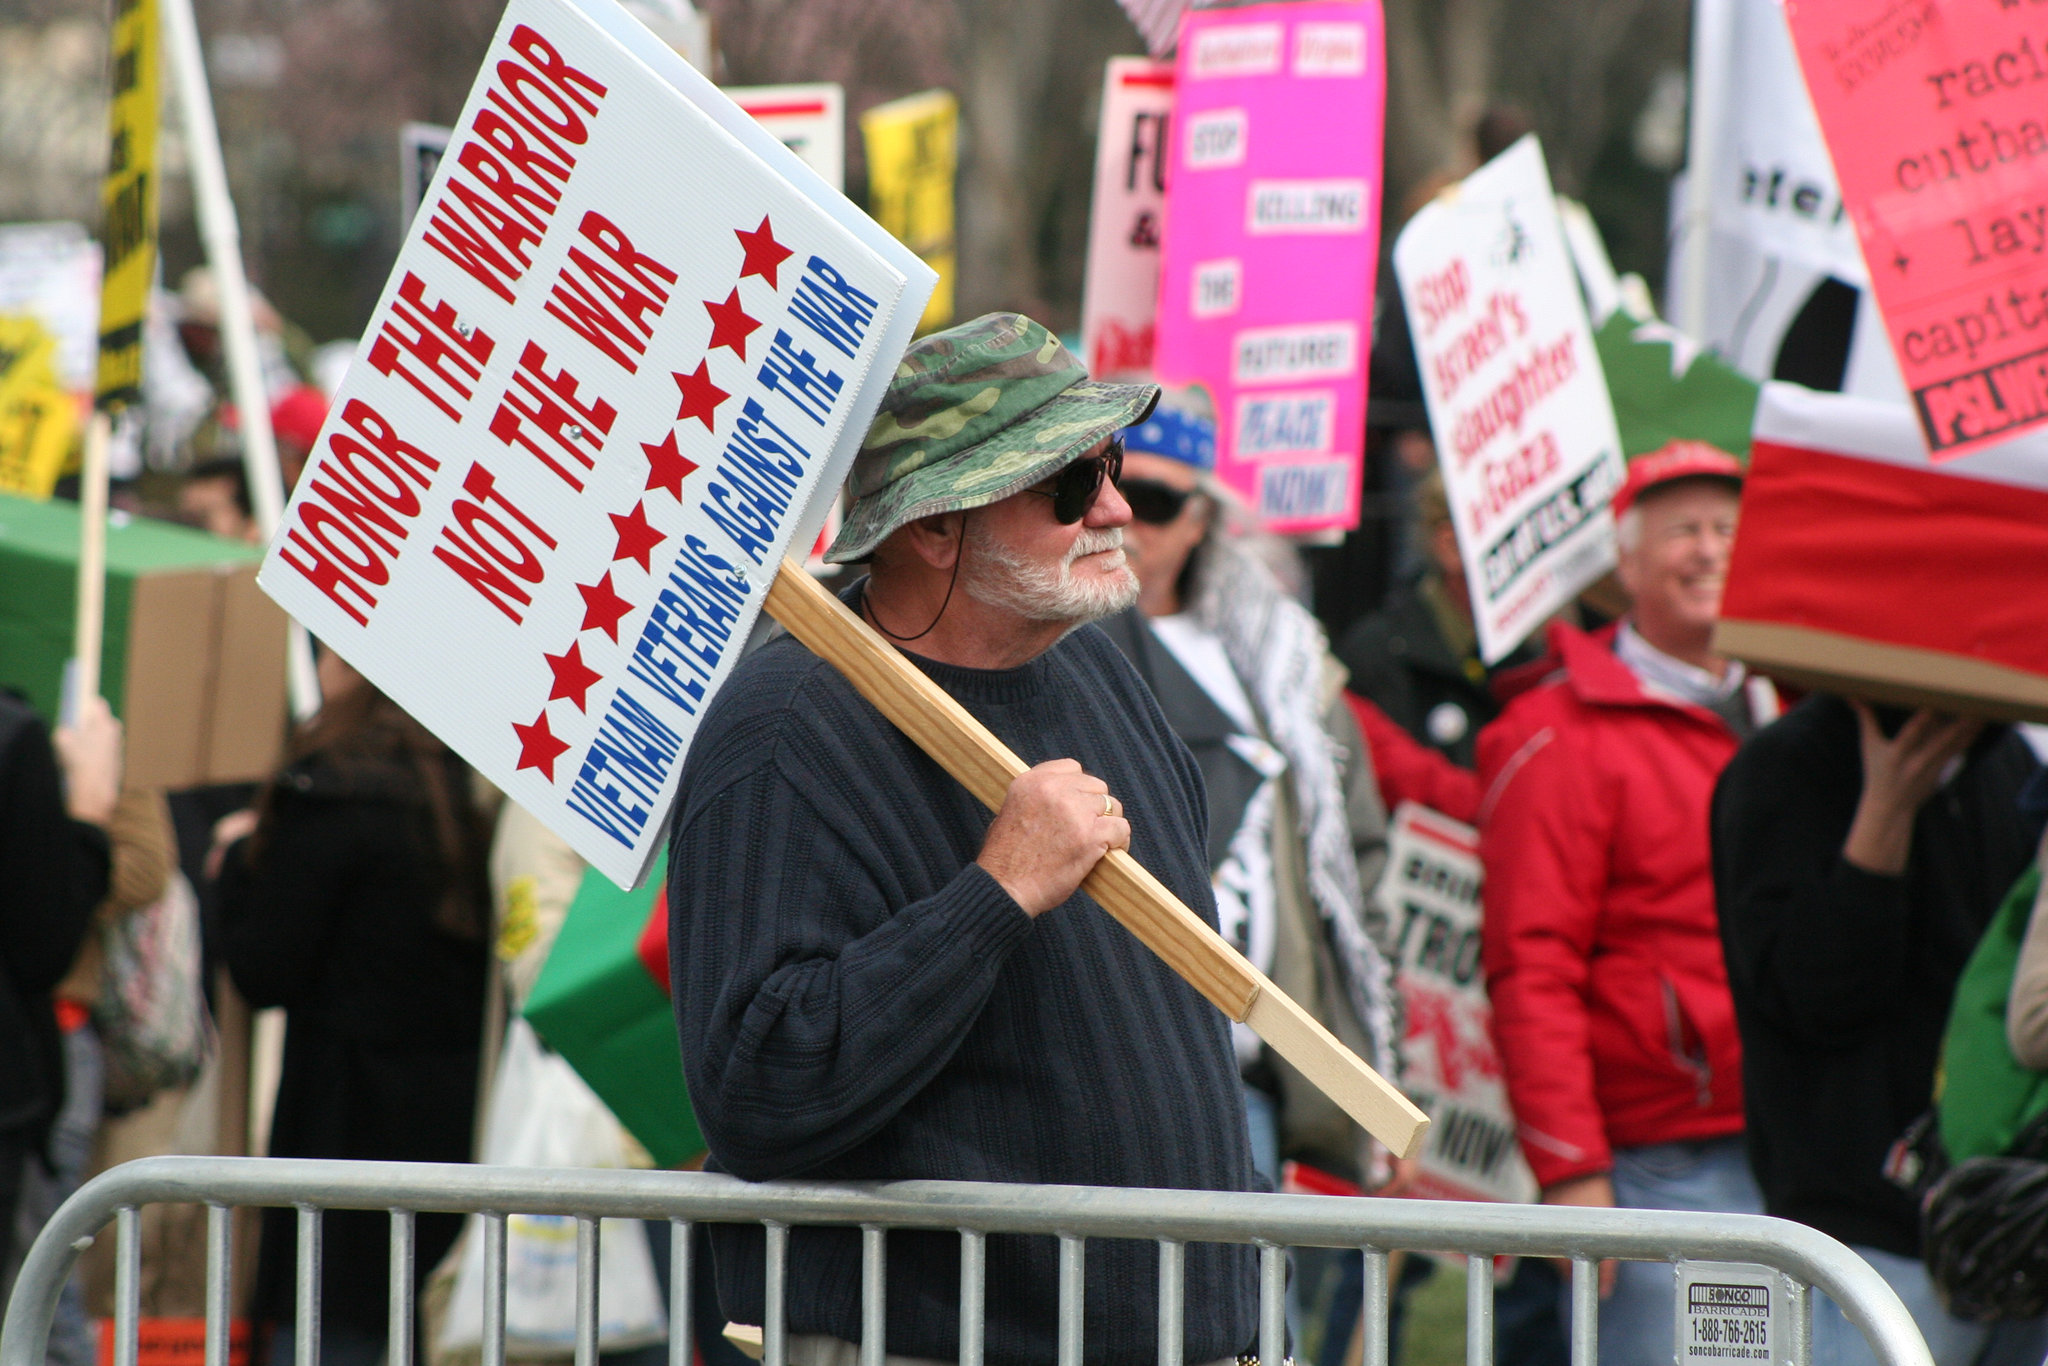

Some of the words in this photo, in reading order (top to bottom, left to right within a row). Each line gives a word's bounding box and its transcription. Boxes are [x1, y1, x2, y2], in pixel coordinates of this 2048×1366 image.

[1927, 36, 2048, 108] raci
[422, 23, 608, 305] WARRIOR
[367, 269, 496, 423] THE
[543, 210, 679, 376] WAR
[787, 255, 879, 361] WAR
[1414, 258, 1470, 335] Stop
[1902, 287, 2048, 365] capit
[488, 338, 618, 493] THE
[757, 328, 844, 427] THE
[278, 398, 441, 628] HONOR
[431, 459, 559, 627] NOT
[700, 396, 812, 567] AGAINST
[626, 533, 752, 716] VETERANS
[565, 687, 684, 851] VIETNAM
[1689, 1345, 1770, 1360] soncobarricade.com
[1692, 1317, 1767, 1345] 1-888-766-2615
[1693, 1305, 1766, 1317] BARRICADE
[1708, 1288, 1751, 1303] SONCO
